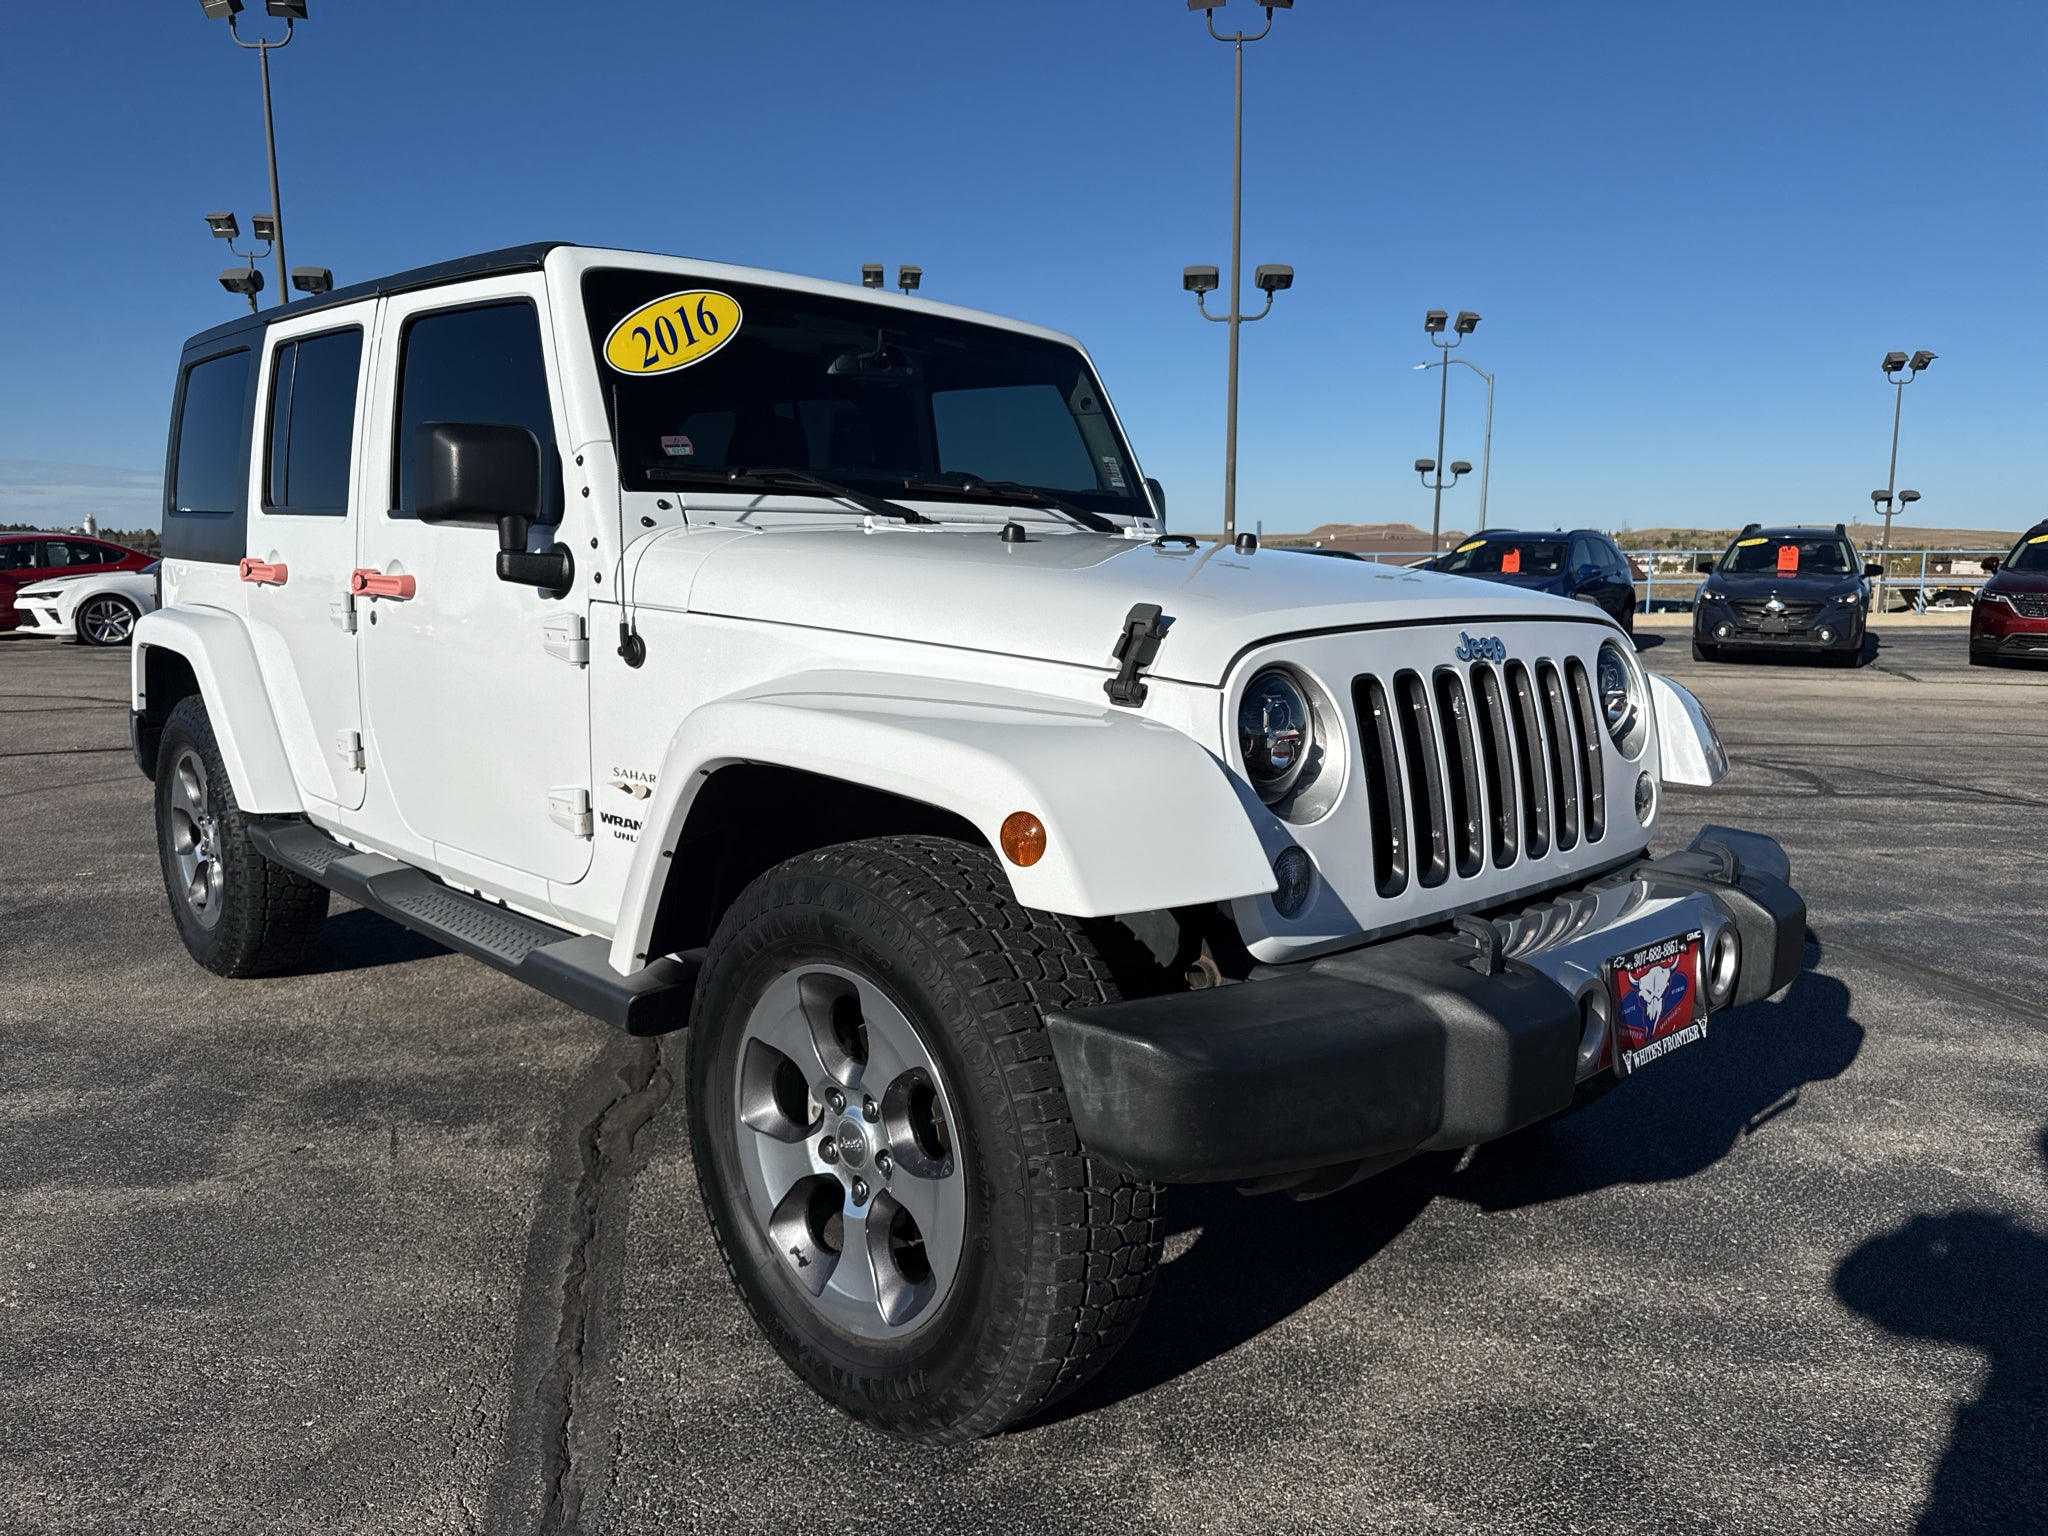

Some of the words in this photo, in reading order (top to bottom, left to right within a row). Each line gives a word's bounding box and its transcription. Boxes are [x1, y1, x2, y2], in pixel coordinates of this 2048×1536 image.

[632, 295, 719, 369] 2016
[1455, 631, 1507, 665] Jeep
[613, 767, 657, 783] SAHAR
[600, 812, 643, 831] WRAN
[614, 831, 639, 843] UNL
[1686, 930, 1702, 941] GMC
[1632, 1040, 1663, 1069] WHITE'S
[1661, 1024, 1700, 1054] FRONTIER
[840, 1136, 863, 1152] Jeep
